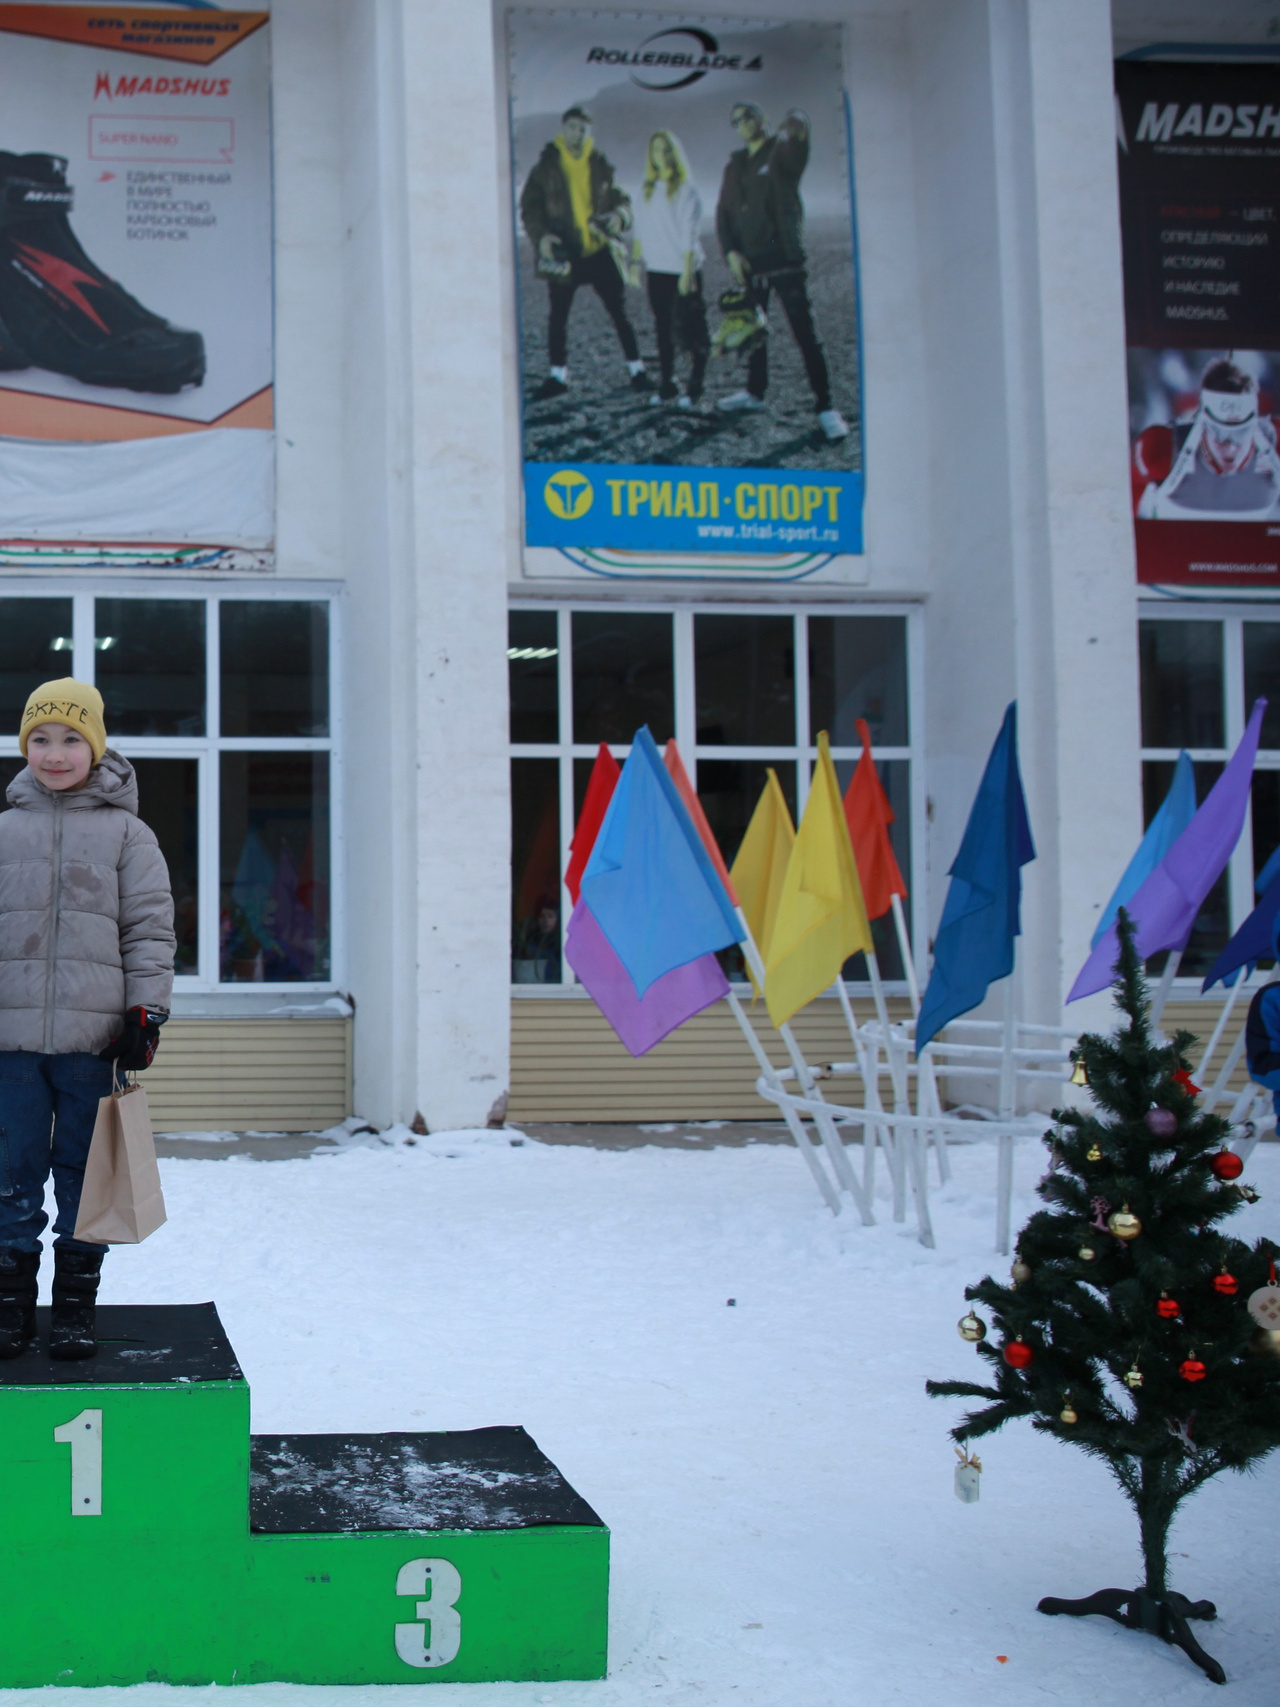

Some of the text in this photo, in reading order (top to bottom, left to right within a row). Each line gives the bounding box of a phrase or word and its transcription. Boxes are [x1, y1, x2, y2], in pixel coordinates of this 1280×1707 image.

[131, 19, 240, 33] спортивных
[121, 34, 216, 45] магазинов
[114, 75, 231, 97] MADSHUS
[126, 169, 232, 184] ЕДИНСТВЕННЫЙ
[126, 200, 211, 213] ПОЛНОСТЬЮ
[126, 214, 217, 227] КАРБОНОВЫЙ
[126, 228, 189, 241] БОТИНОК
[697, 523, 839, 543] www.trial-sport.ru
[54, 1408, 104, 1517] 1
[394, 1558, 463, 1669] 3
